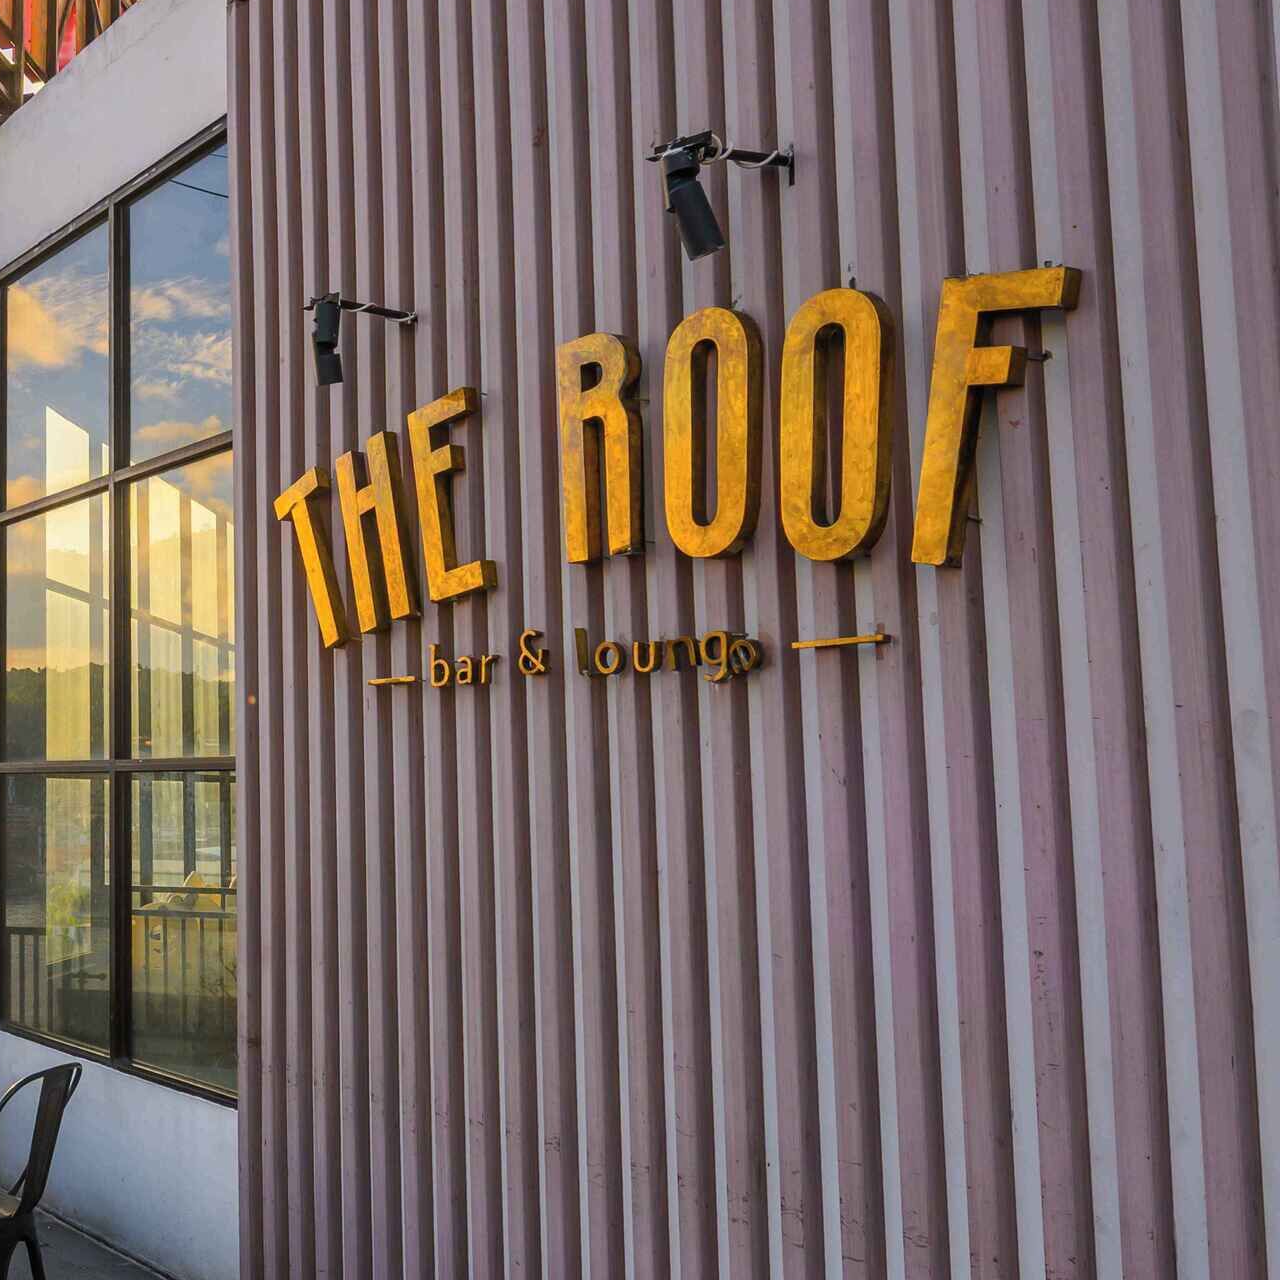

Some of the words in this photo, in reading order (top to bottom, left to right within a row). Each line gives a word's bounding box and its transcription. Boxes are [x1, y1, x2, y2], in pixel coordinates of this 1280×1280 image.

[274, 387, 497, 648] THE
[556, 266, 1081, 567] ROOF
[428, 643, 498, 688] bar
[519, 628, 549, 675] &
[574, 627, 762, 683] lounge
